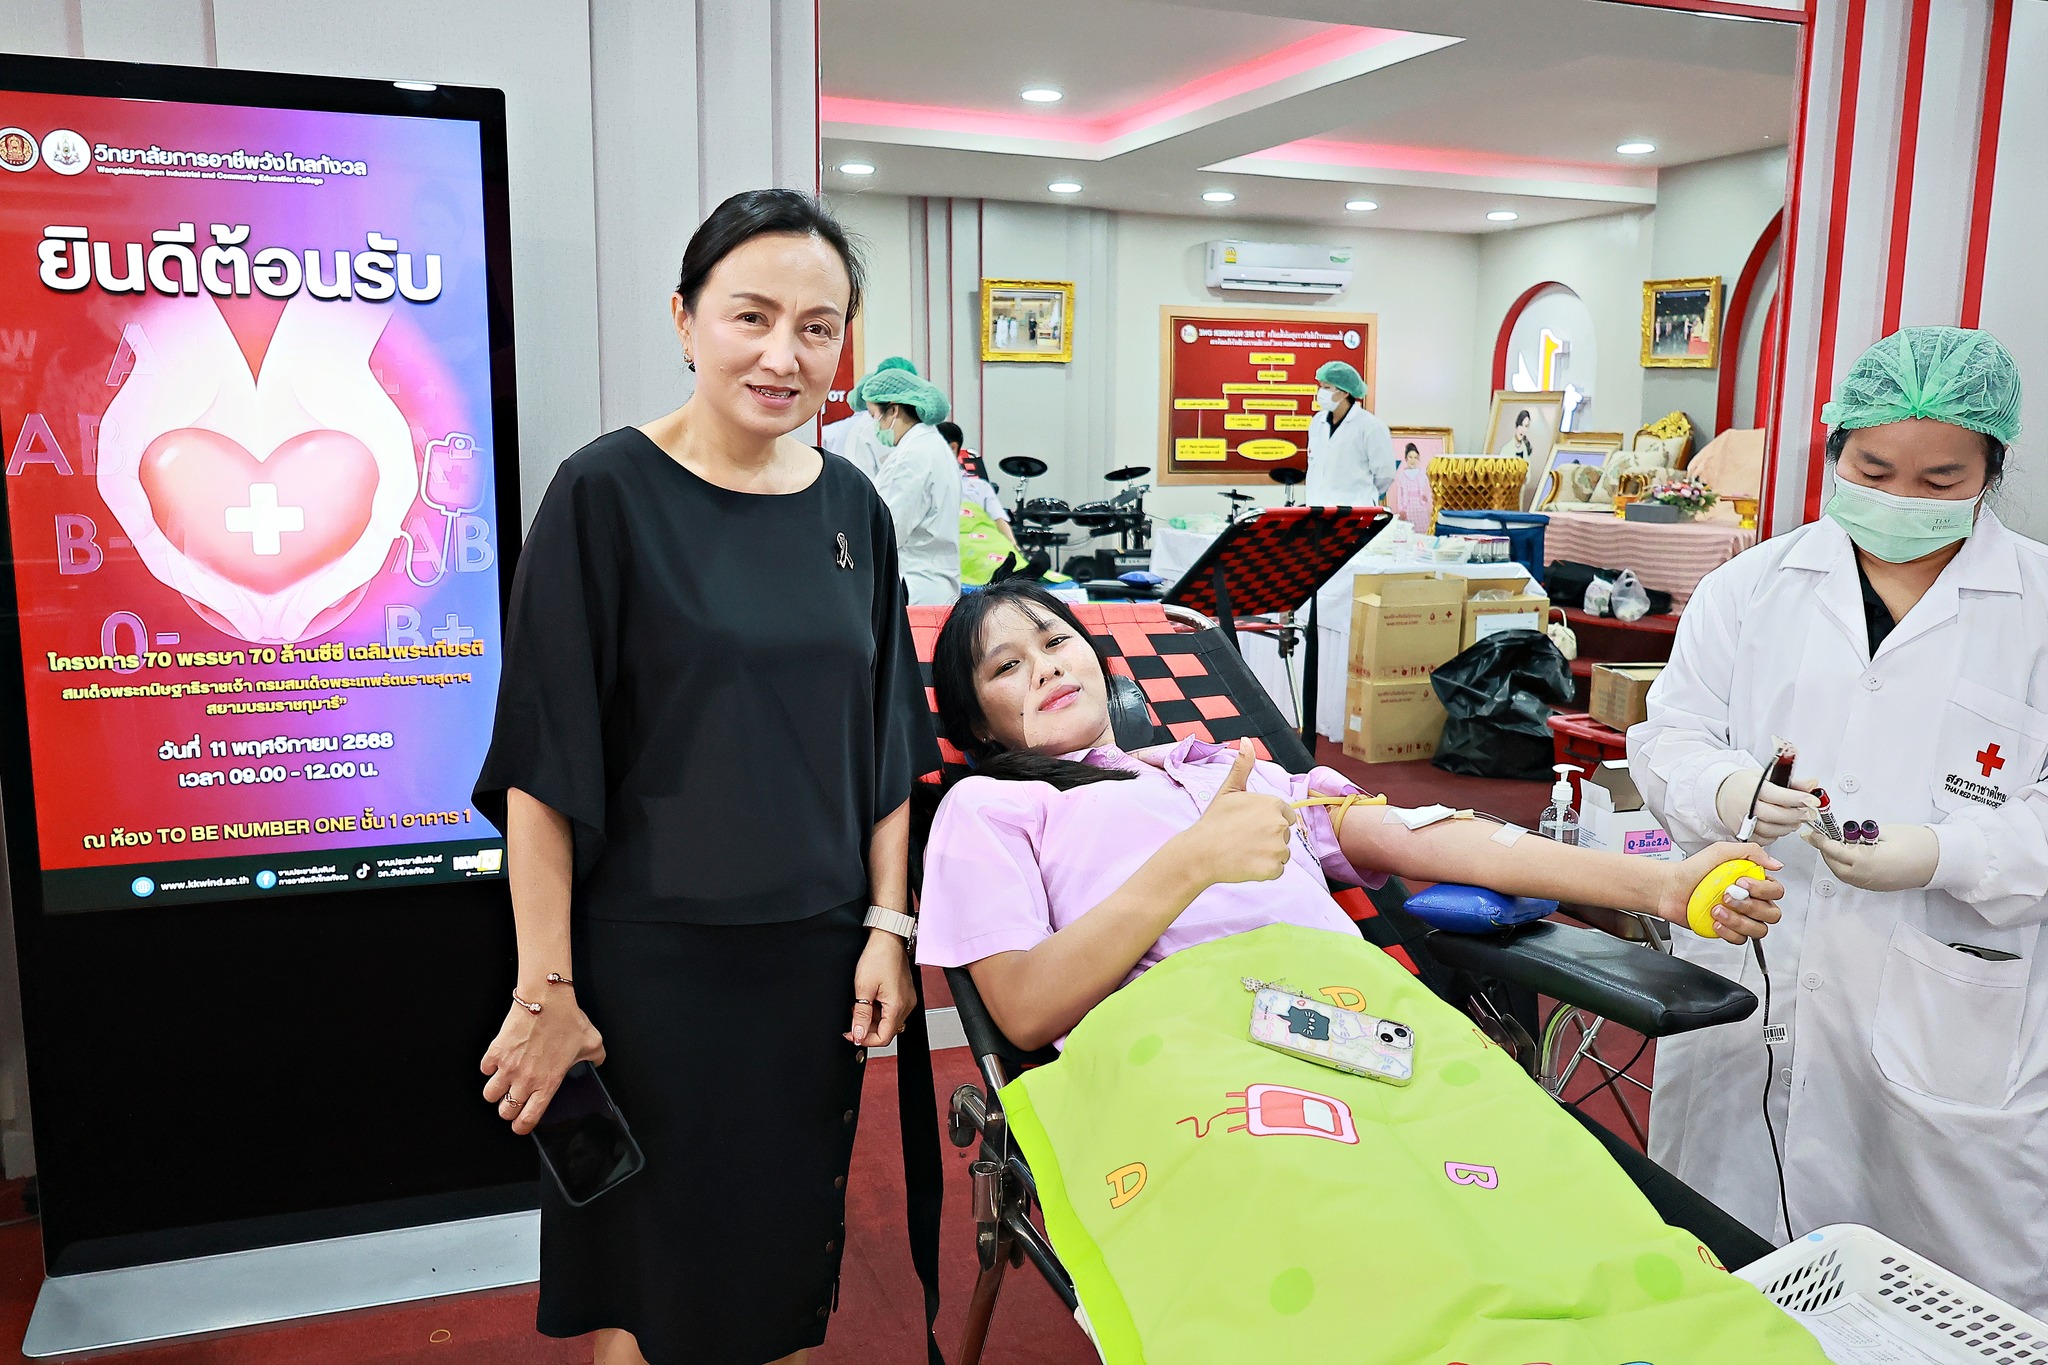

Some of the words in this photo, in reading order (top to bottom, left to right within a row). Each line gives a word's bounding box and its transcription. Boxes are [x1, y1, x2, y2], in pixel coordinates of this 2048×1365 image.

[94, 144, 368, 175] วิทยาลัยการอาชีพวังไกลกังวล
[166, 169, 201, 178] Industrial
[201, 171, 216, 179] and
[216, 172, 257, 182] Community
[258, 174, 296, 183] Education
[37, 222, 444, 303] ยินดีต้อนรับ
[47, 652, 140, 671] โครงการ
[144, 652, 172, 668] 70
[176, 650, 245, 668] พรรษา
[249, 647, 276, 664] 70
[280, 642, 344, 663] ล้านซีซี
[349, 639, 484, 660] เฉลิมพระเกียรติ
[62, 678, 253, 700] สมเด็จพระกนิษฐาธิราชเจ้า
[158, 734, 201, 760] วันที่
[209, 740, 227, 757] 11
[231, 736, 338, 758] พฤศจิกายน
[342, 732, 394, 750] 2568
[178, 770, 225, 787] เวลา
[229, 765, 287, 785] 09.00
[290, 770, 301, 778] -
[303, 762, 356, 780] 12.00
[359, 761, 379, 777] น.
[1944, 784, 1959, 795] THAI
[1946, 774, 2007, 803] สภากาชาดไทย
[83, 835, 106, 849] ณ
[110, 828, 152, 847] ห้อง
[156, 827, 186, 844] TO
[191, 825, 219, 842] BE
[223, 819, 310, 840] NUMBER
[314, 816, 357, 834] ONE
[360, 807, 386, 830] ชั้น
[389, 813, 397, 828] 1
[402, 810, 459, 828] อาคาร
[463, 808, 471, 823] 1
[1628, 837, 1669, 850] Q-Bac2A
[160, 875, 250, 891] www.kkwind.ac.th
